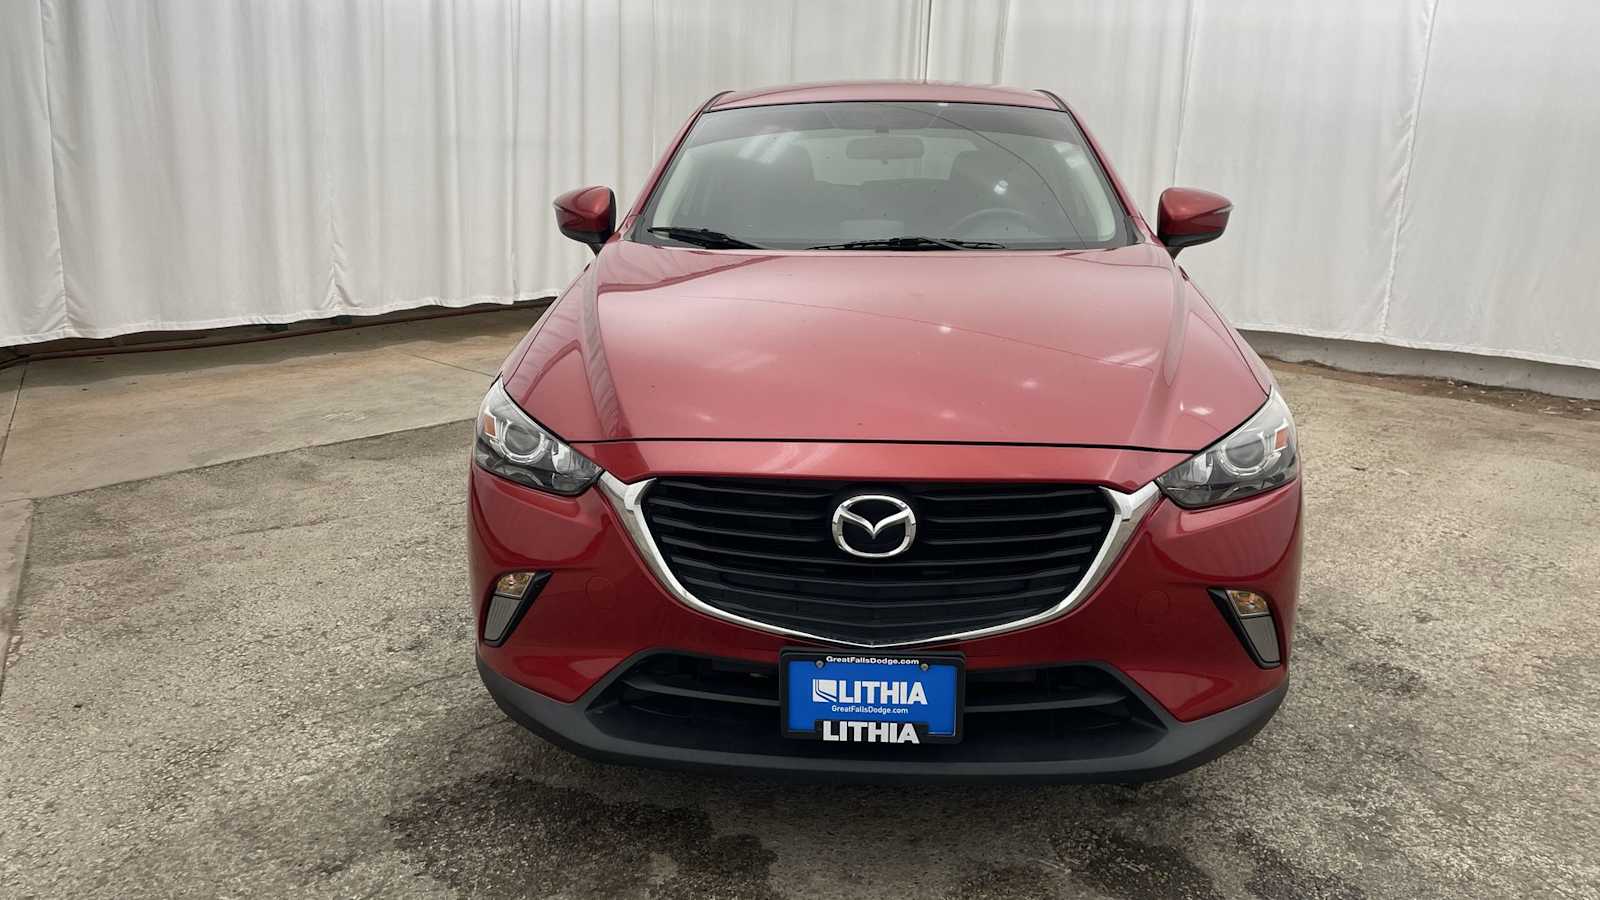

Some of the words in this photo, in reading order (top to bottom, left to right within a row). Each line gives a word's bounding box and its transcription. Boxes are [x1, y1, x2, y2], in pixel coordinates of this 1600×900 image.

[826, 655, 920, 666] GreatFallsDodge.com
[839, 679, 928, 705] LITHIA
[831, 704, 909, 715] GreatFallsDodge.com
[822, 720, 920, 744] LITHIA
